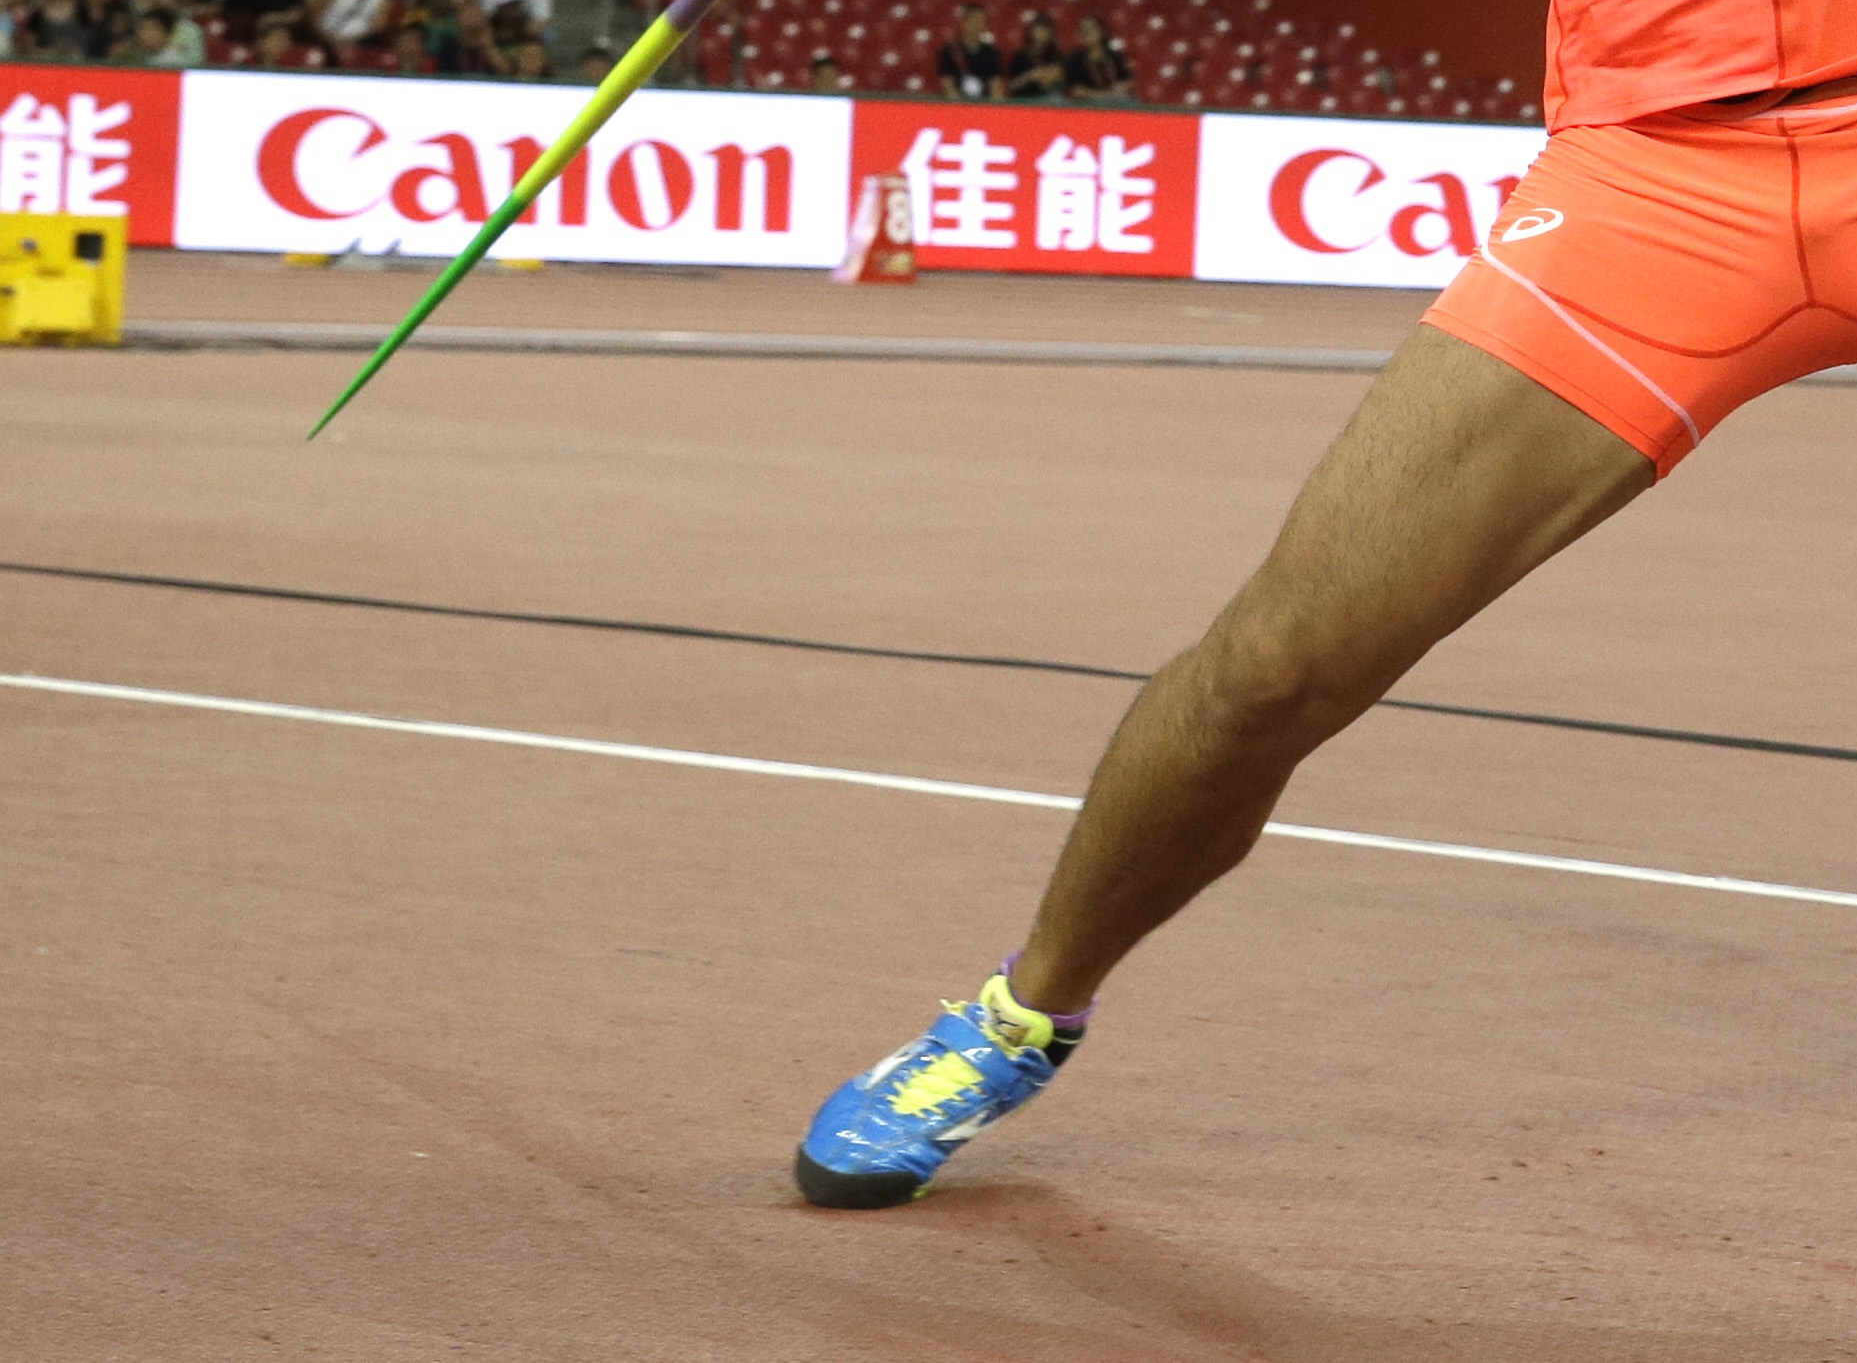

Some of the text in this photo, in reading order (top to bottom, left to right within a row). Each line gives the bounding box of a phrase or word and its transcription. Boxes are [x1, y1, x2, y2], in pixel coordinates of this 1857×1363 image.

[0, 93, 132, 215] 能
[255, 106, 795, 233] Canon
[902, 128, 1156, 253] 佳能
